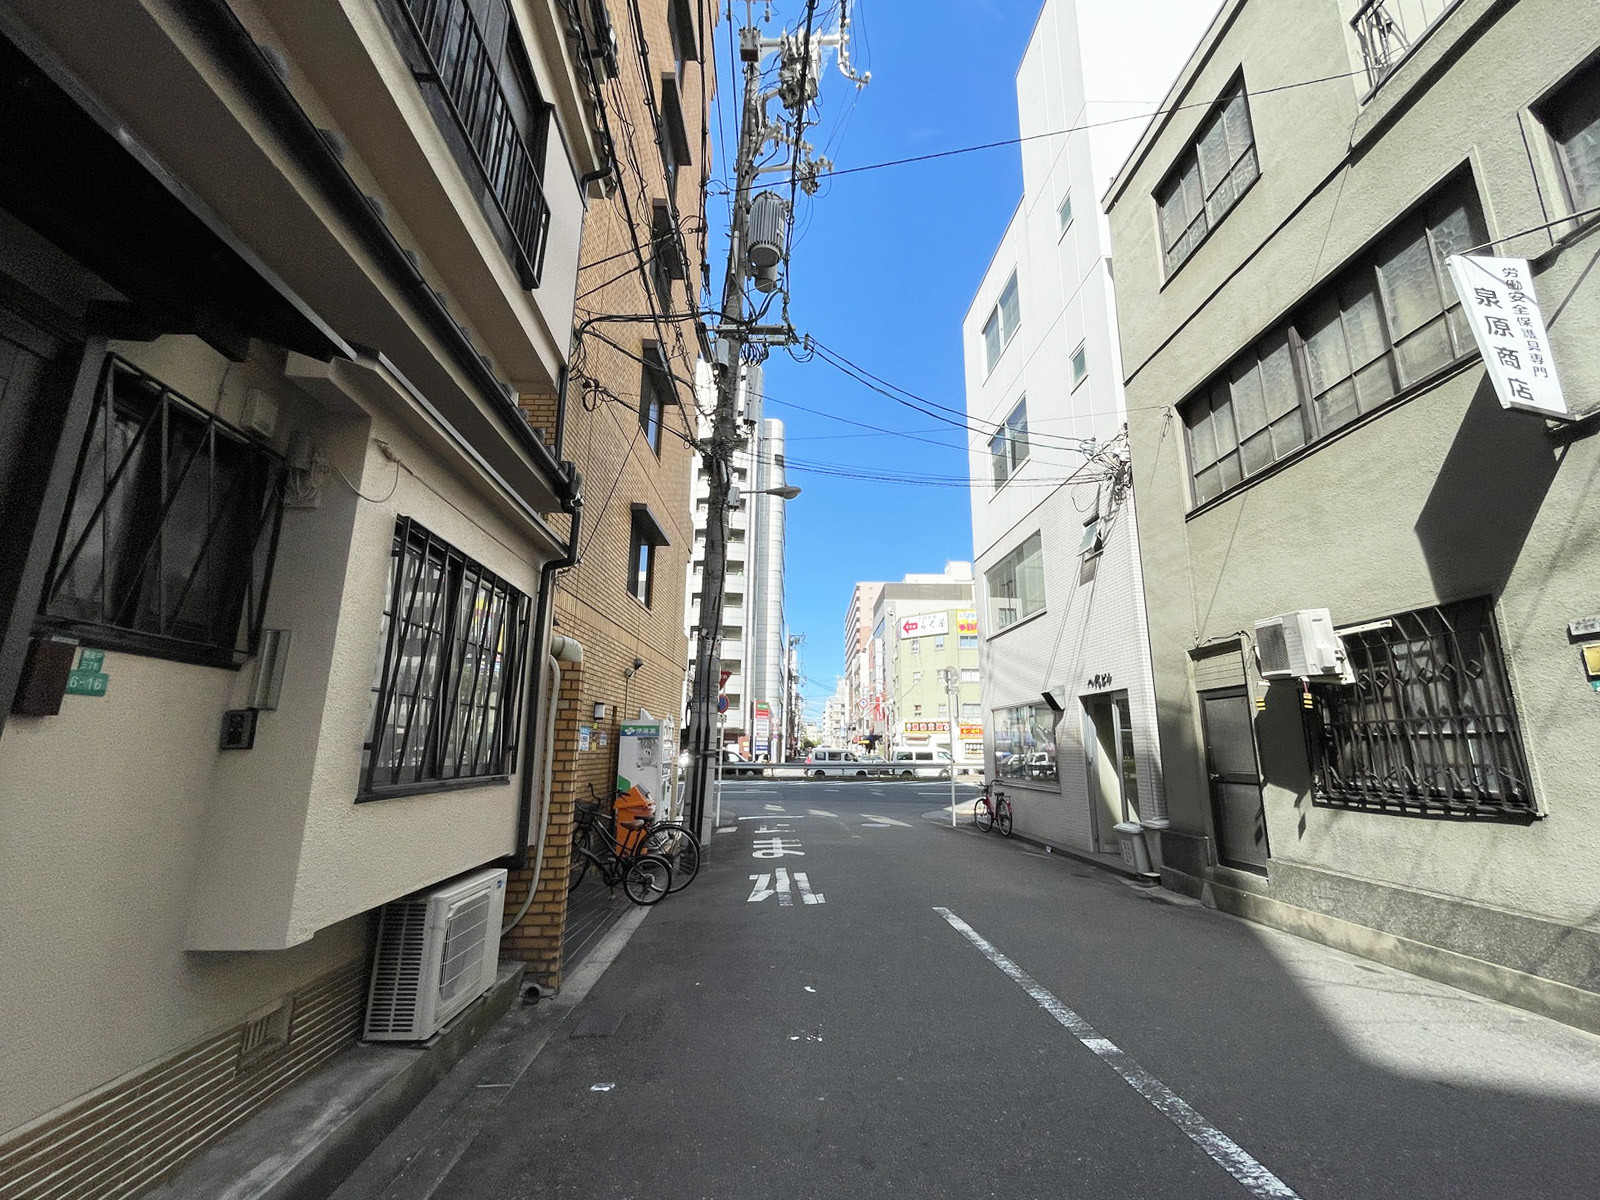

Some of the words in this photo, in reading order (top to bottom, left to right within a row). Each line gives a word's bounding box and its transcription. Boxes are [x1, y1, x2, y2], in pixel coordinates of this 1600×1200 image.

[1473, 287, 1535, 402] 泉原商店
[69, 675, 103, 690] 6-16
[747, 823, 826, 906] 止まれ
